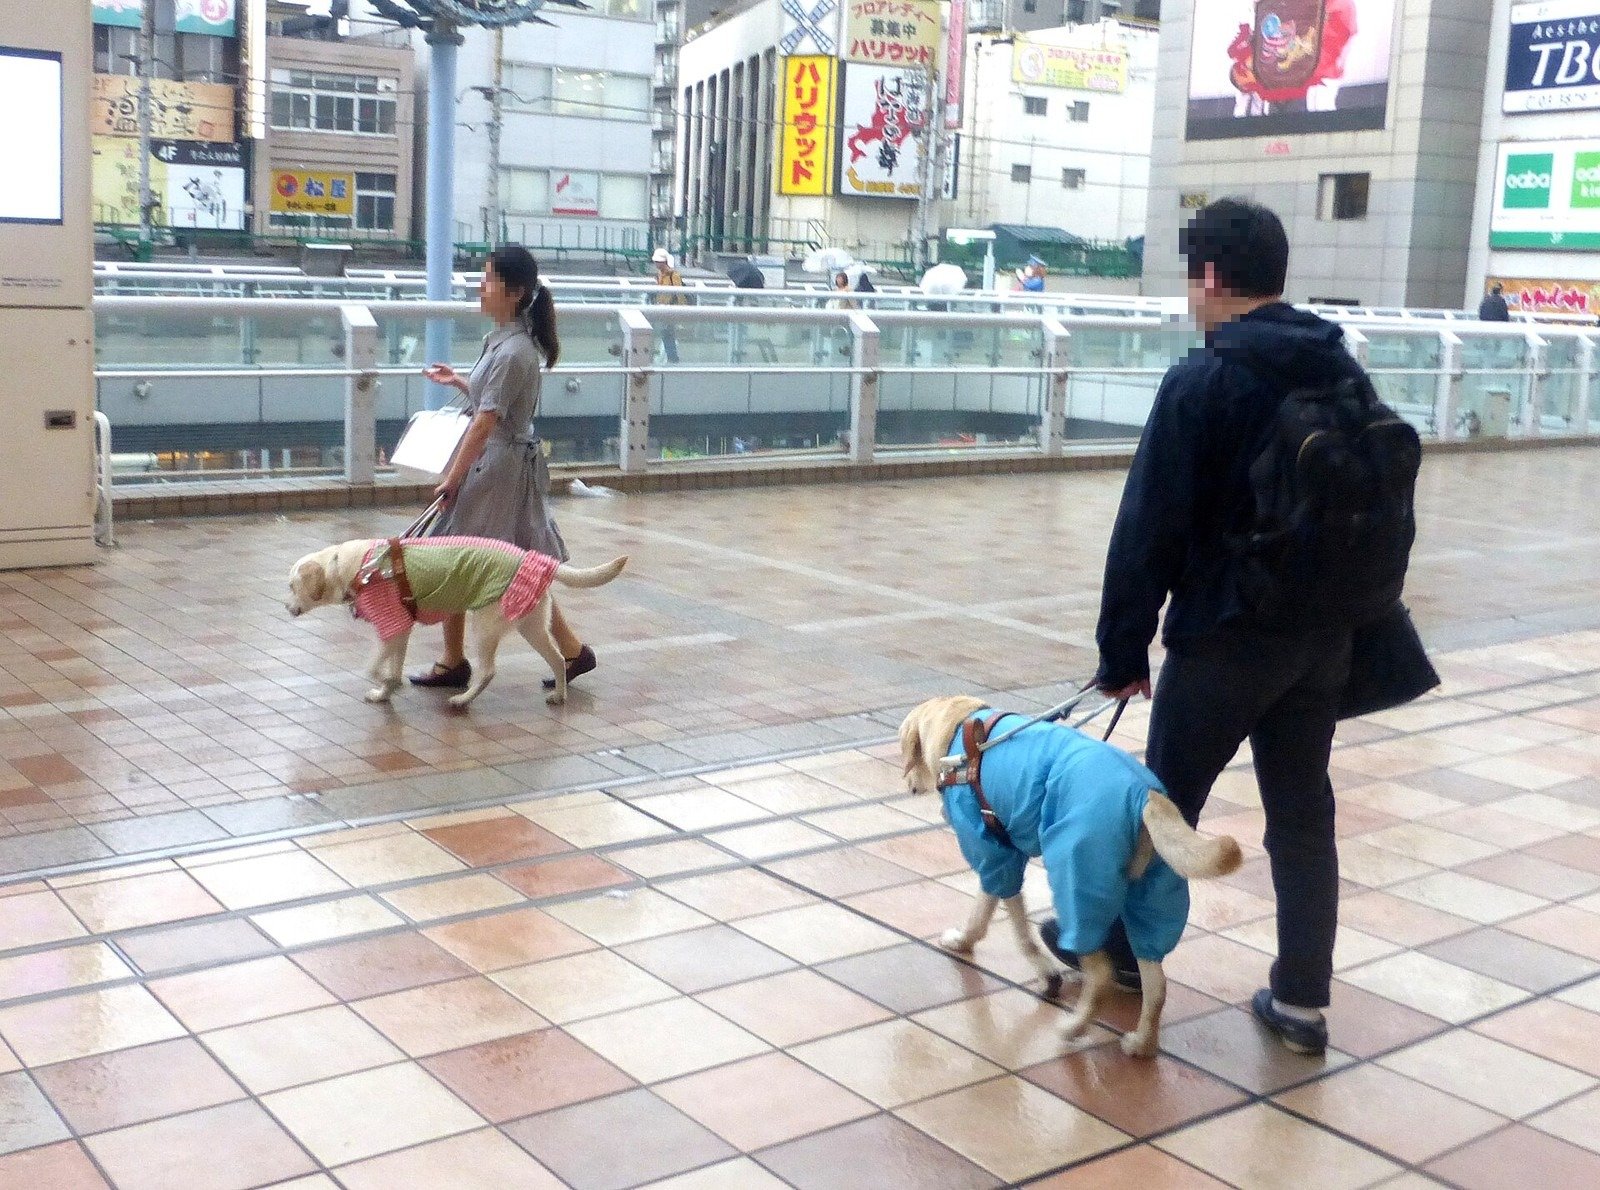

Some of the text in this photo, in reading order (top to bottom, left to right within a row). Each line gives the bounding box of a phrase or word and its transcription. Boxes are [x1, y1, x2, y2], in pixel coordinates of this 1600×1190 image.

[869, 18, 917, 39] 募集中
[1529, 39, 1600, 87] TB
[791, 61, 821, 186] ハリウッド
[158, 145, 178, 161] 4F
[304, 176, 347, 199] 松屋
